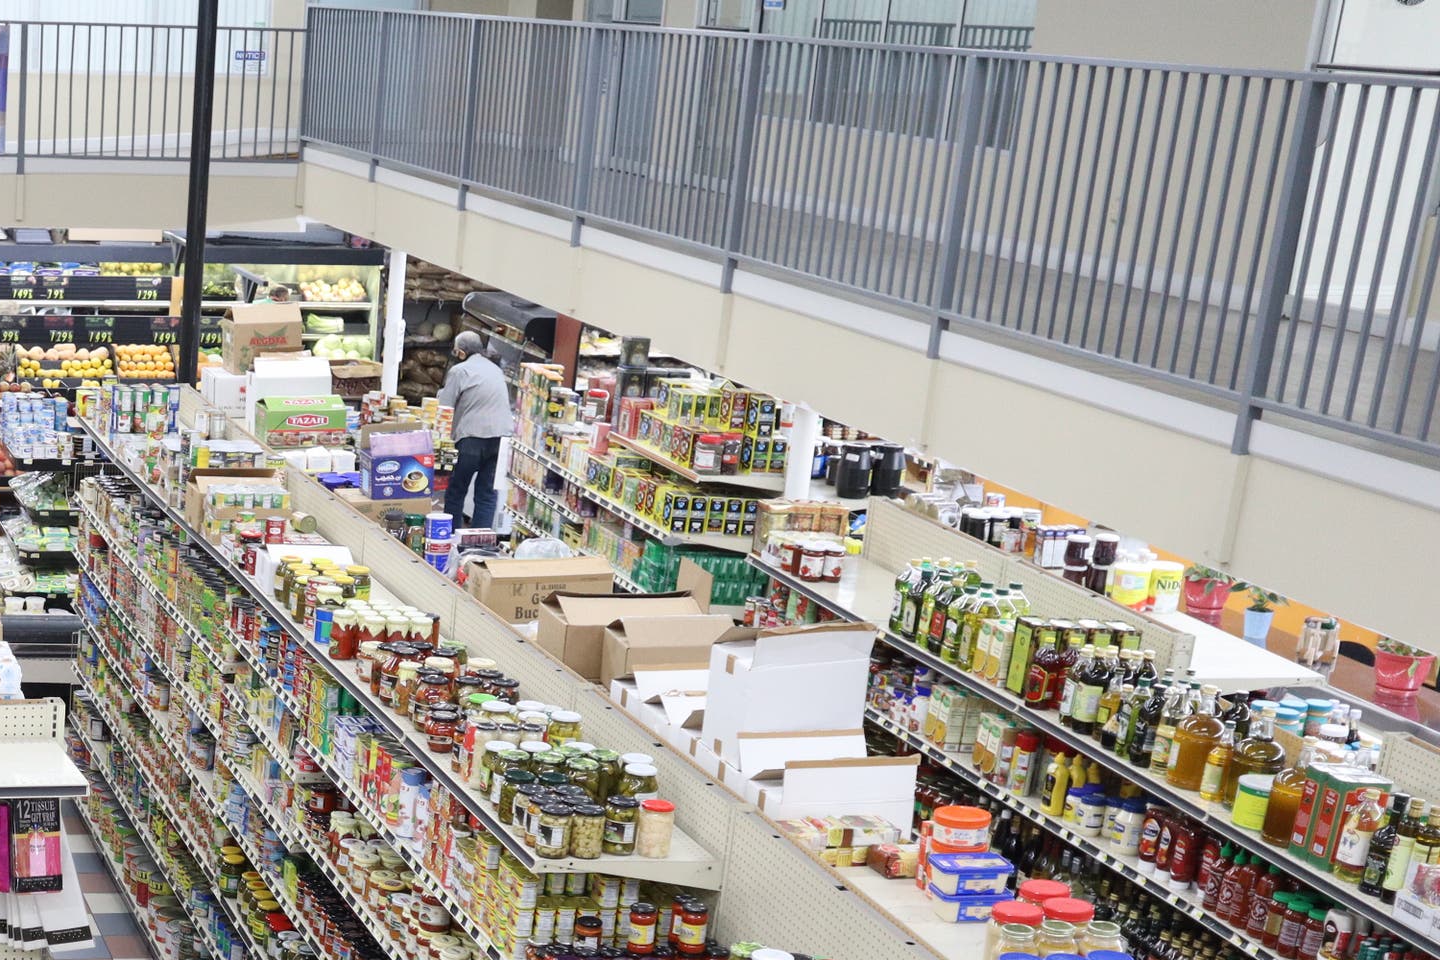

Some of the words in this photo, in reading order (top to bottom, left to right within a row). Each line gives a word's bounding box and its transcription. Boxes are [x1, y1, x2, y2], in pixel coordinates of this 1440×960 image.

[291, 416, 326, 425] TAZAH
[17, 800, 31, 819] 12
[30, 800, 56, 812] TISSUE
